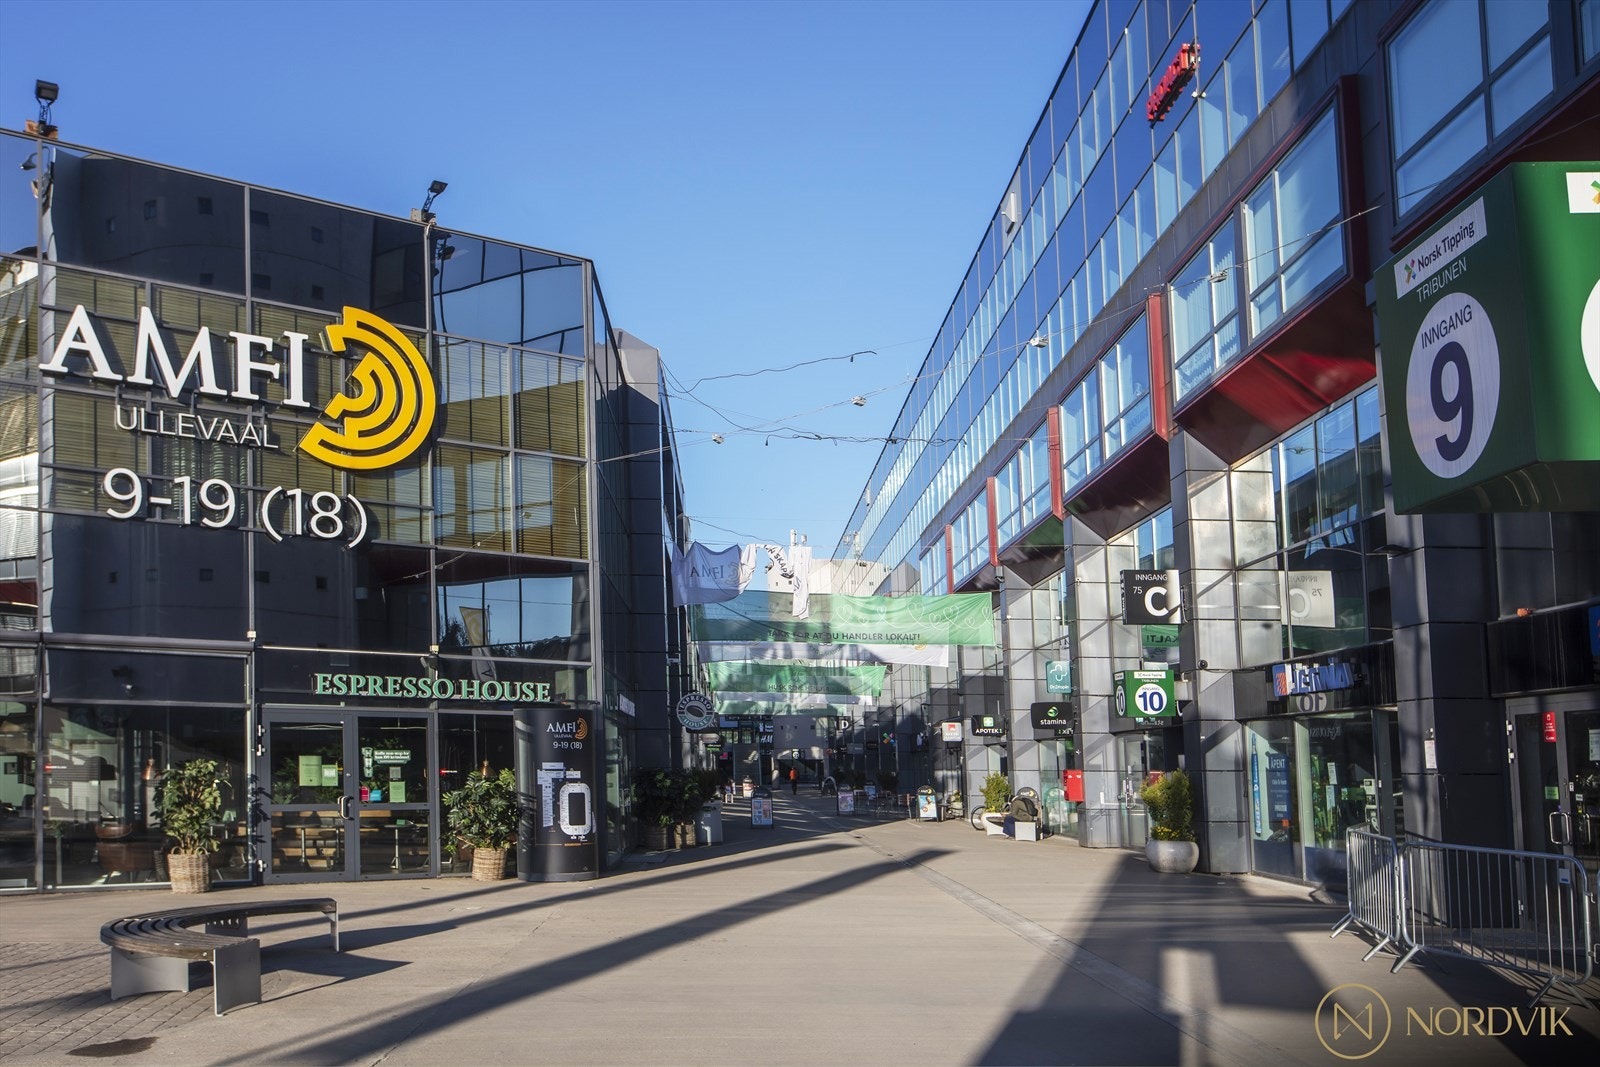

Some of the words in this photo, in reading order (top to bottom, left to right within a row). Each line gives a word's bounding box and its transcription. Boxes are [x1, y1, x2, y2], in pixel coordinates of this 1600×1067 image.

[1417, 244, 1441, 273] Norsk
[1441, 220, 1475, 252] Tipping
[1416, 257, 1467, 303] TRIBUNEN
[1421, 304, 1473, 349] INNGANG
[39, 304, 311, 408] AMFI
[1429, 341, 1474, 462] 9
[114, 404, 279, 450] ULLEVAAL
[103, 467, 237, 529] 9-19
[261, 485, 368, 549] (18)
[1133, 586, 1143, 595] 75
[1144, 586, 1170, 617] C
[812, 632, 823, 640] AT
[828, 632, 839, 640] DU
[842, 632, 883, 641] HANDLER
[885, 633, 920, 641] LOKALT!
[314, 672, 454, 700] ESPRESSO
[459, 678, 551, 703] HOUSE
[680, 694, 712, 710] ESPRESSO
[1138, 691, 1164, 712] 10
[546, 721, 576, 733] AMFI
[683, 717, 709, 728] HOUSE
[1040, 718, 1067, 726] stamina
[552, 741, 569, 750] 9-19
[570, 741, 583, 750] (18)
[1270, 756, 1286, 769] ÅPENT
